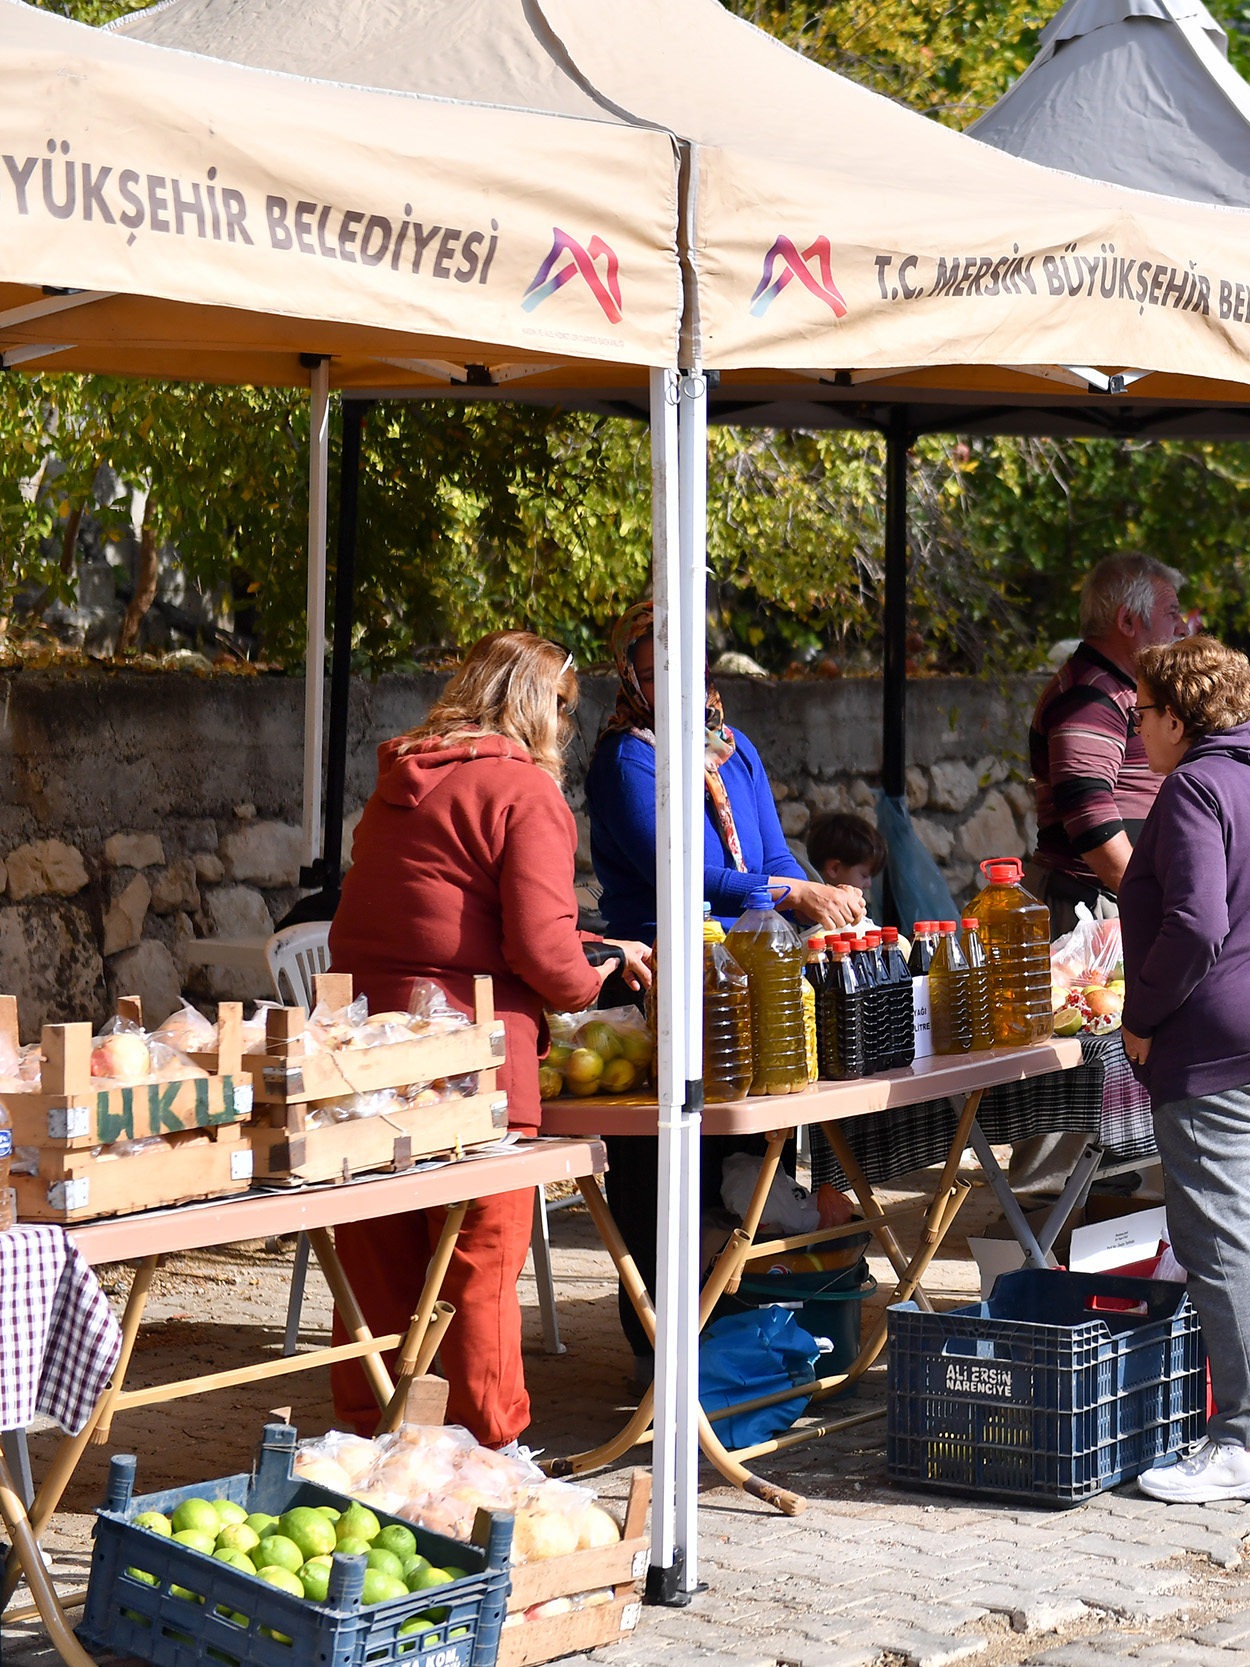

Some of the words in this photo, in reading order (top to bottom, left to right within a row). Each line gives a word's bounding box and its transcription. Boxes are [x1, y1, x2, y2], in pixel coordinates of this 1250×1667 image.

[1, 138, 255, 247] YÜKŞEHİR
[266, 195, 499, 285] BELEDİYESİ
[874, 255, 924, 301] T.C.
[927, 242, 1038, 297] MERSİN
[1043, 242, 1211, 316] BÜYÜKŞEHİR
